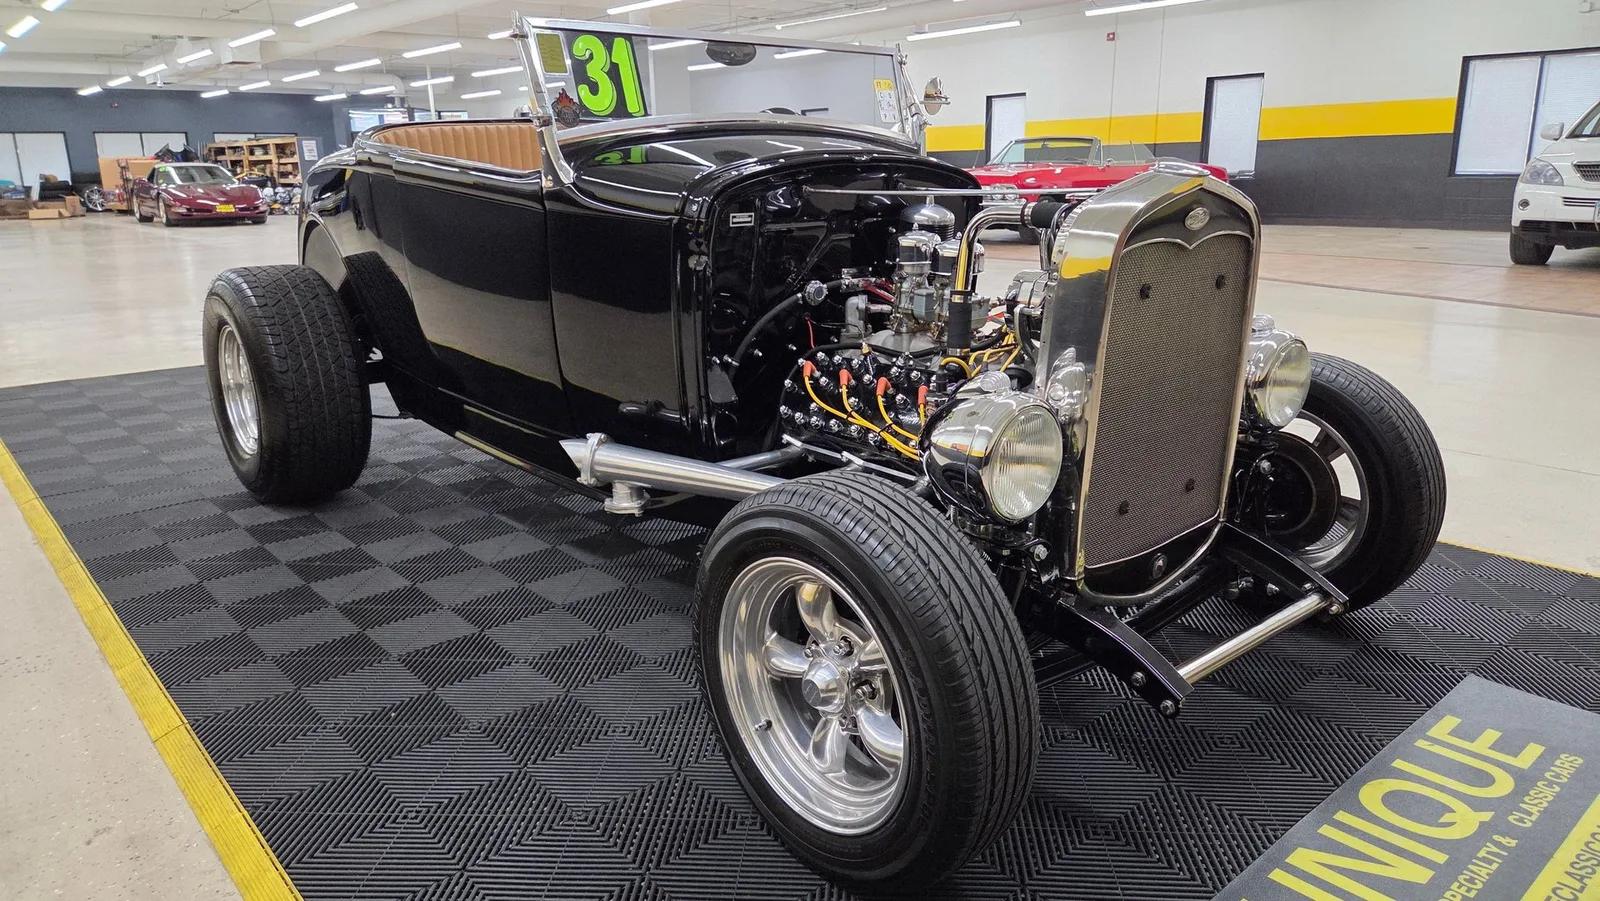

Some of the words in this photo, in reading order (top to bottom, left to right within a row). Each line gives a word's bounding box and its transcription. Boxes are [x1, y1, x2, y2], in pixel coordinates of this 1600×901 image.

[572, 35, 645, 117] 31
[1438, 842, 1508, 901] PECIALTY
[1492, 834, 1518, 848] &
[1507, 780, 1561, 828] CLASSIC
[1544, 753, 1584, 783] CARS
